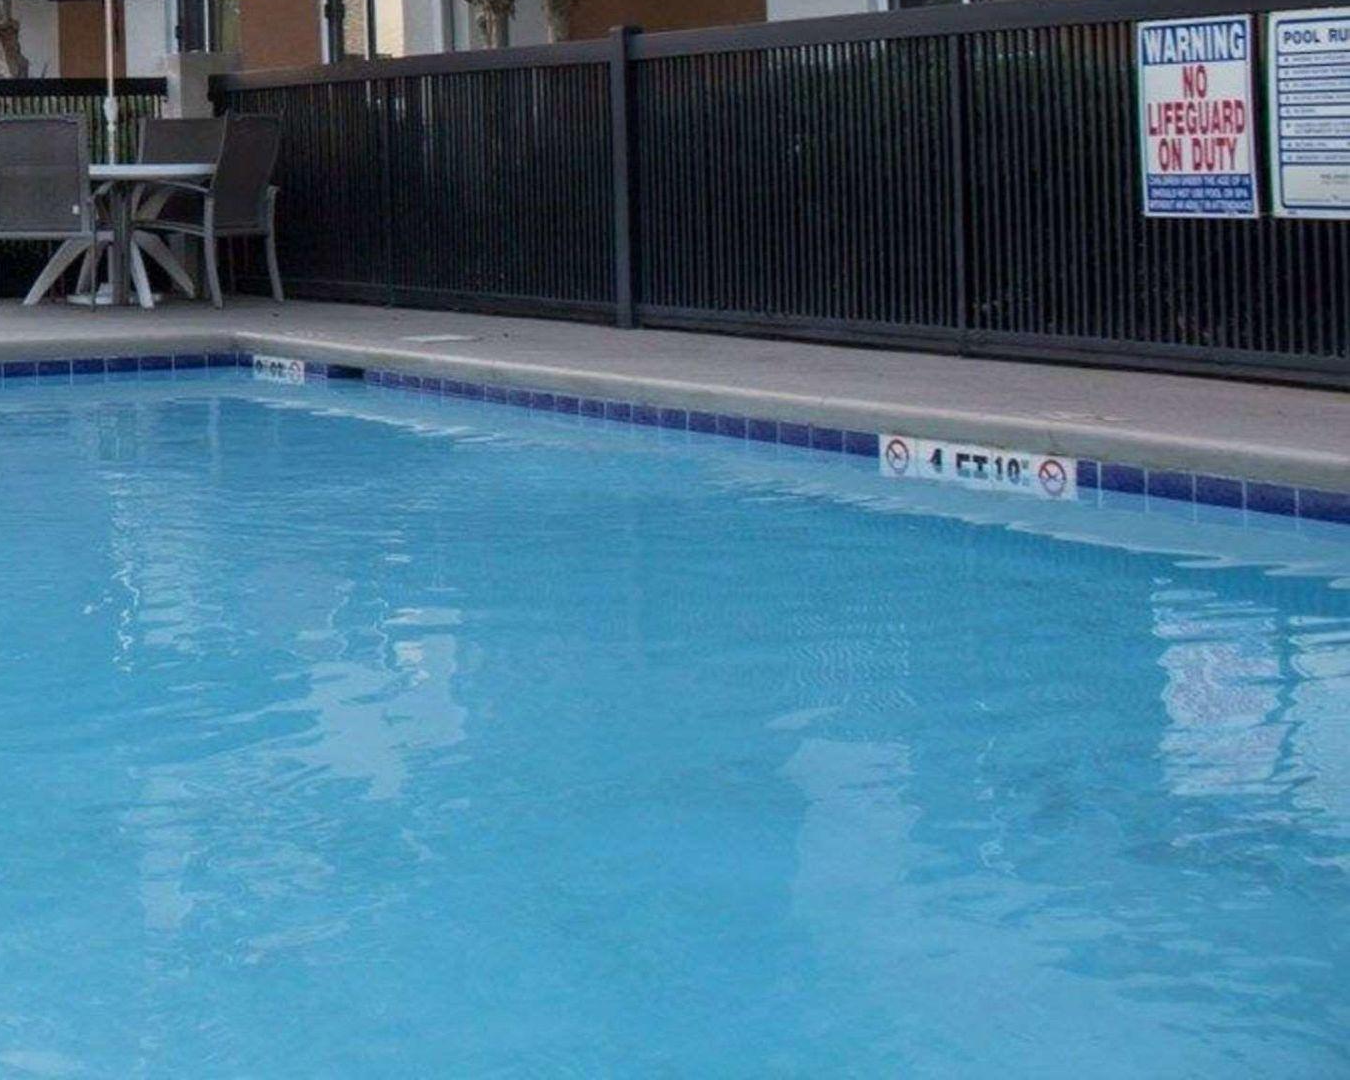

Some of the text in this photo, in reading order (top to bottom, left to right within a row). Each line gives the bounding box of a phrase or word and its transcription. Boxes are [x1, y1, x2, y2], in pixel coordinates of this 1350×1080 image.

[1143, 22, 1245, 63] WARNING
[1284, 29, 1320, 44] POOL
[1183, 66, 1207, 98] NO
[1147, 100, 1245, 136] LIFEGUARD
[1158, 137, 1238, 171] ON DUTY
